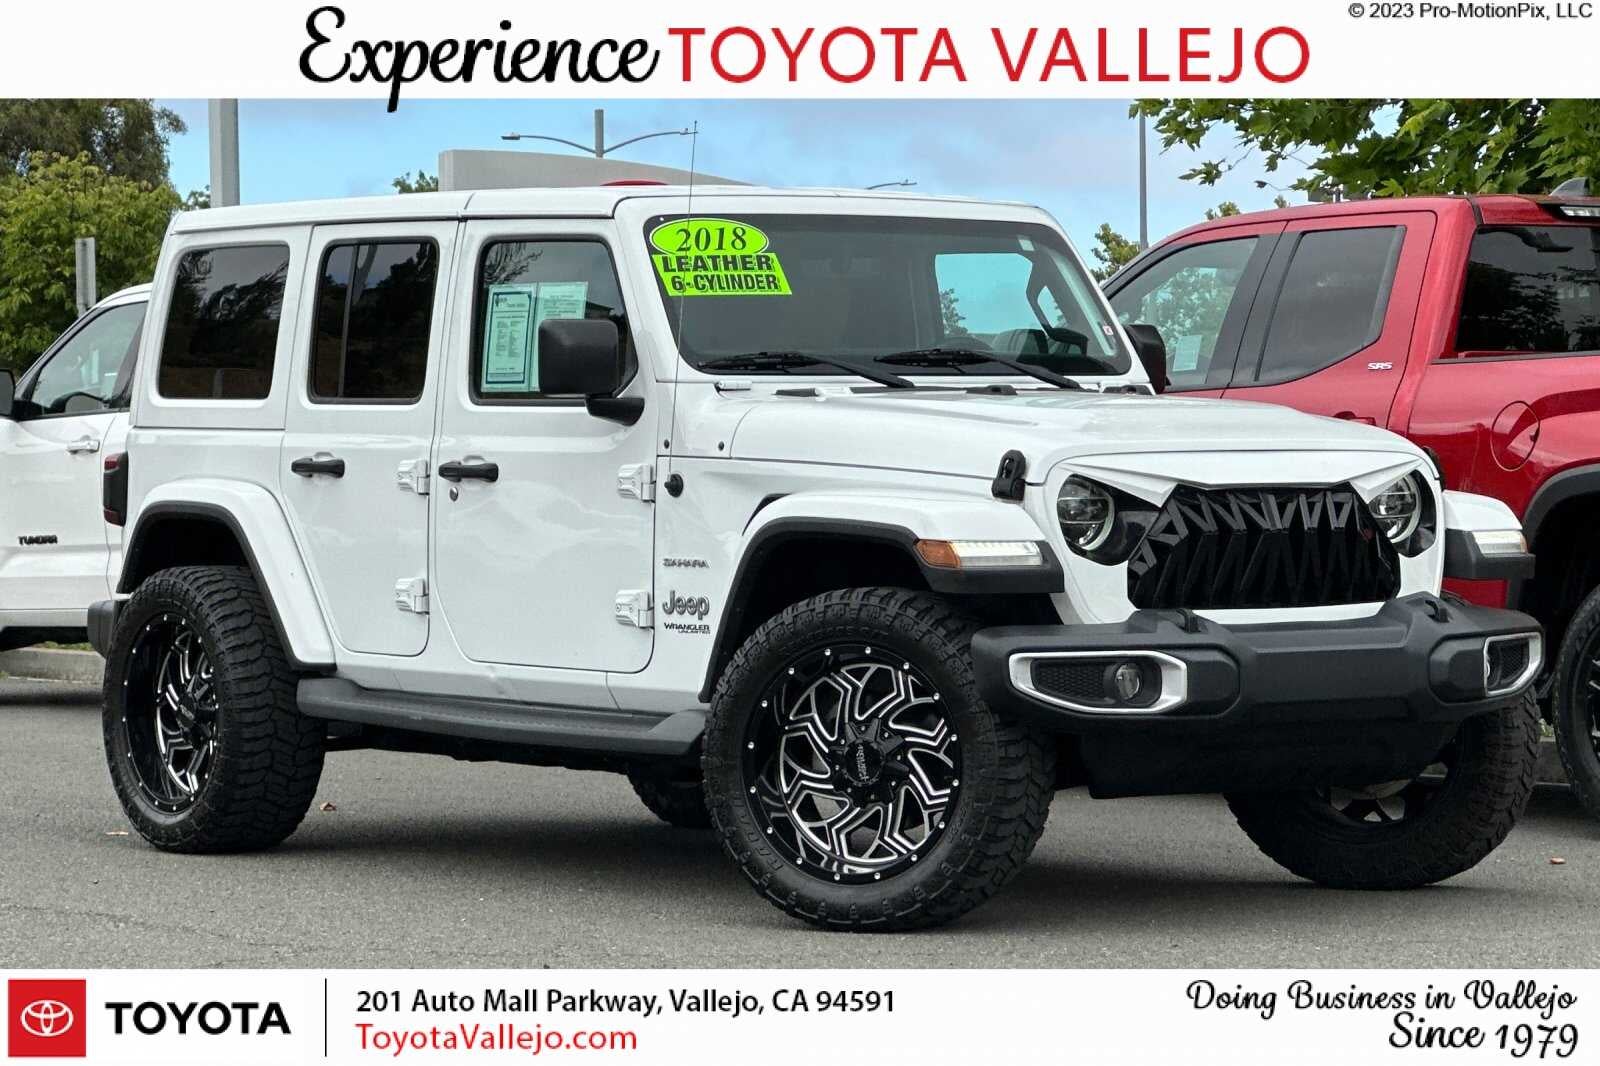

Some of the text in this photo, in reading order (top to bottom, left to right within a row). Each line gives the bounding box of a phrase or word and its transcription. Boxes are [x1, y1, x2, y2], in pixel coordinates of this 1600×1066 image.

[675, 226, 748, 252] 2018
[662, 254, 774, 273] LEATHER
[671, 274, 781, 293] 6-CYLINDER
[663, 558, 710, 569] SAHARA
[662, 590, 710, 621] Jeep
[664, 622, 710, 631] WRANGLER
